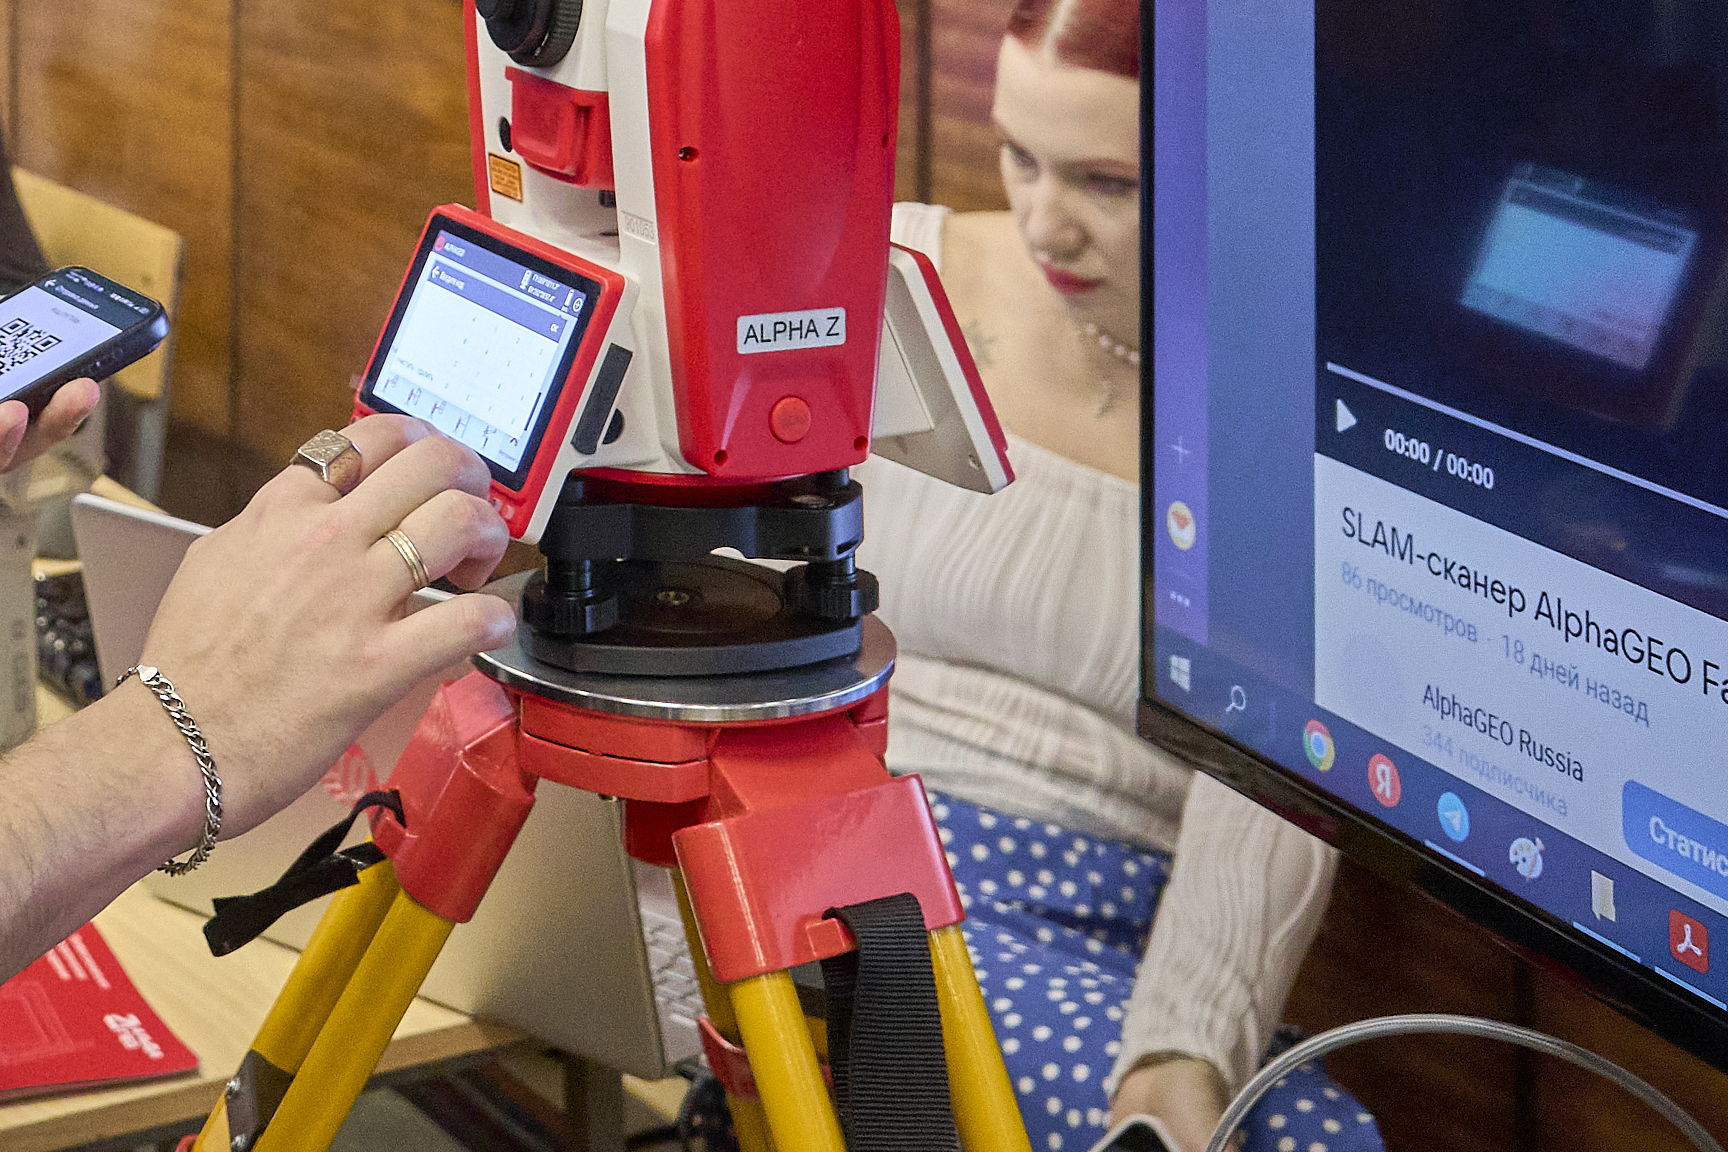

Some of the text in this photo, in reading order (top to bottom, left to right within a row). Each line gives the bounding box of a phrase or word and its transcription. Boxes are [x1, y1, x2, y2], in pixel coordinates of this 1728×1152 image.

[743, 315, 840, 345] ALPHA Z
[1384, 428, 1430, 465] 00:00
[1446, 452, 1494, 490] 00:00
[1342, 506, 1526, 618] SLAM-сканер
[1534, 591, 1692, 685] AlphaGEO
[1341, 561, 1650, 728] 86 просмотров 18 дней назад
[1422, 684, 1584, 783] AlphaGEO Russia
[1423, 724, 1568, 817] 344 подписчика
